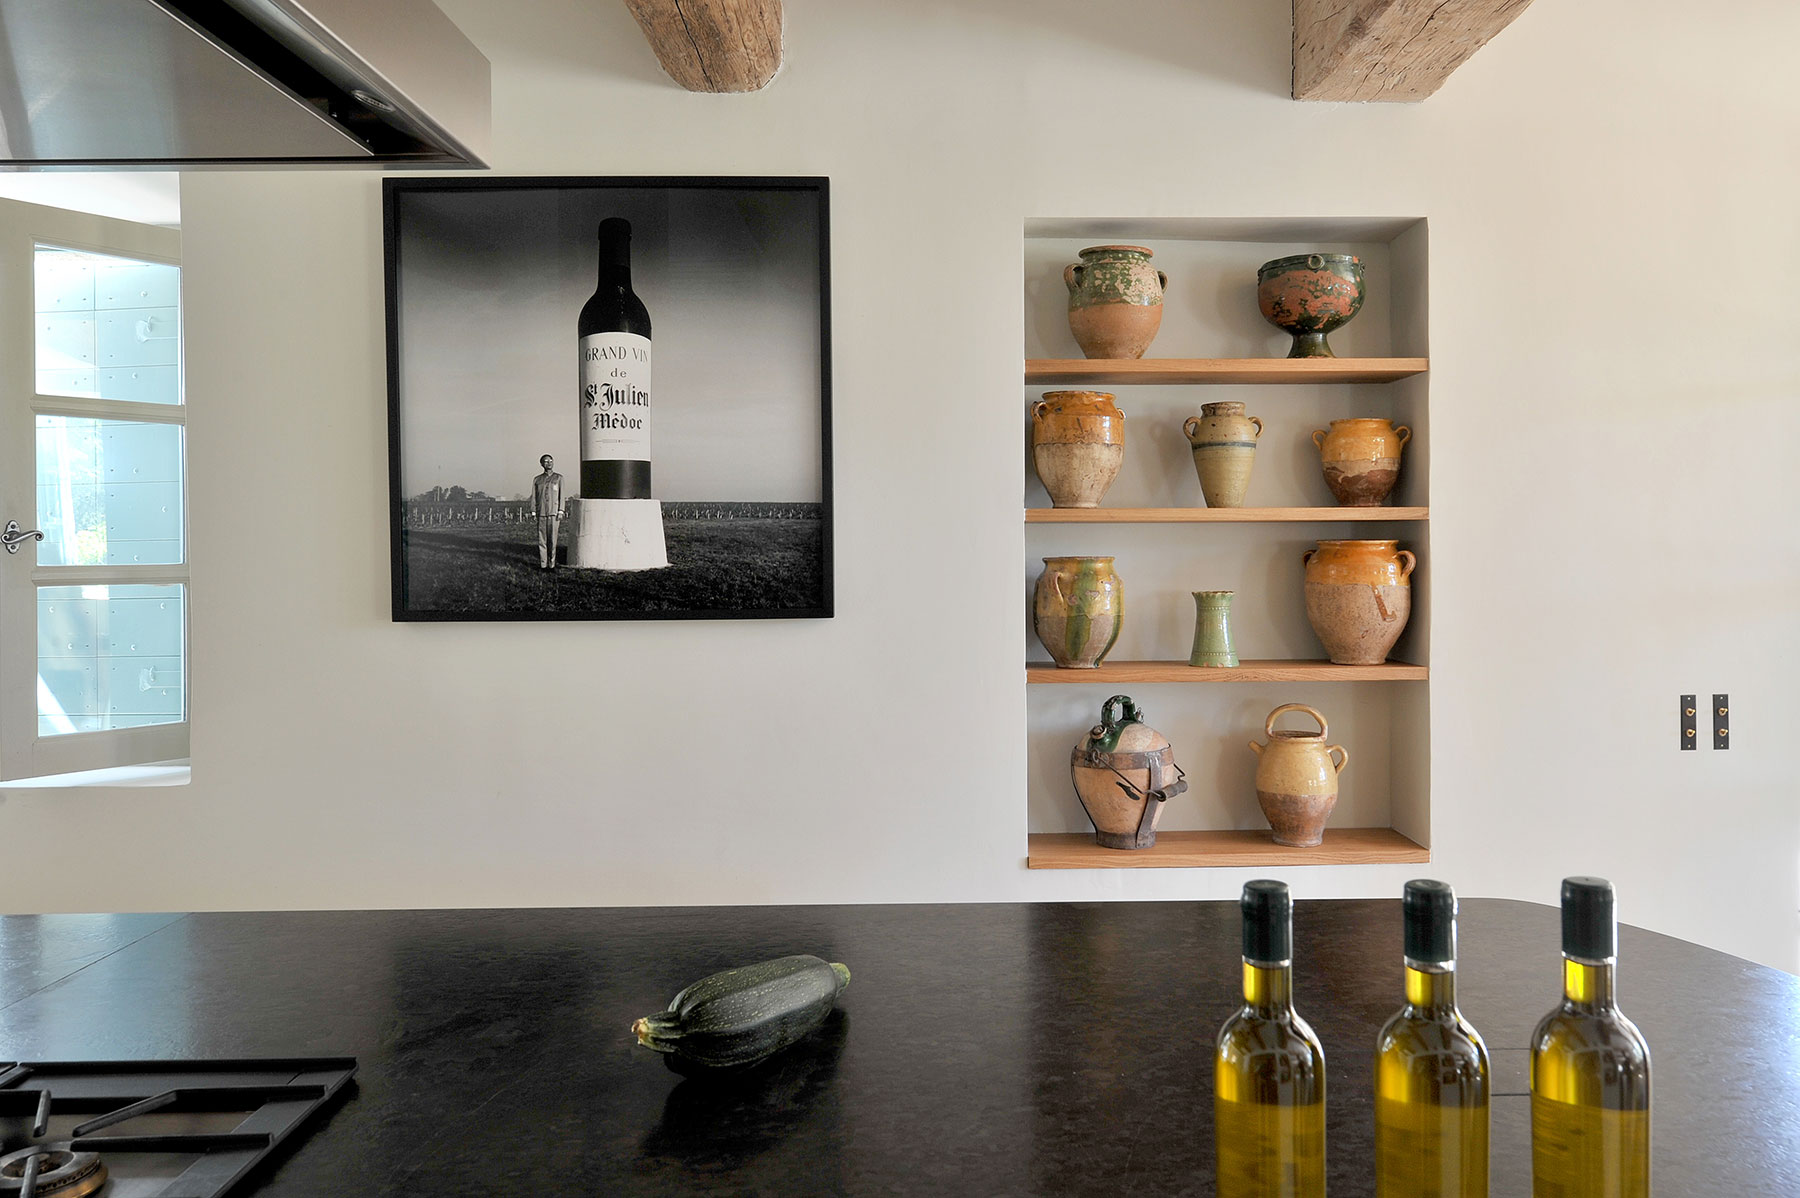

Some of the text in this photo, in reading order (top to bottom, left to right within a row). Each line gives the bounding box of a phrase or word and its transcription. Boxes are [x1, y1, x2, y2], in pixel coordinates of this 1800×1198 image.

[585, 346, 649, 363] GRAND VIN
[610, 367, 627, 378] de
[599, 382, 649, 411] Julien
[592, 412, 643, 430] Médoc
